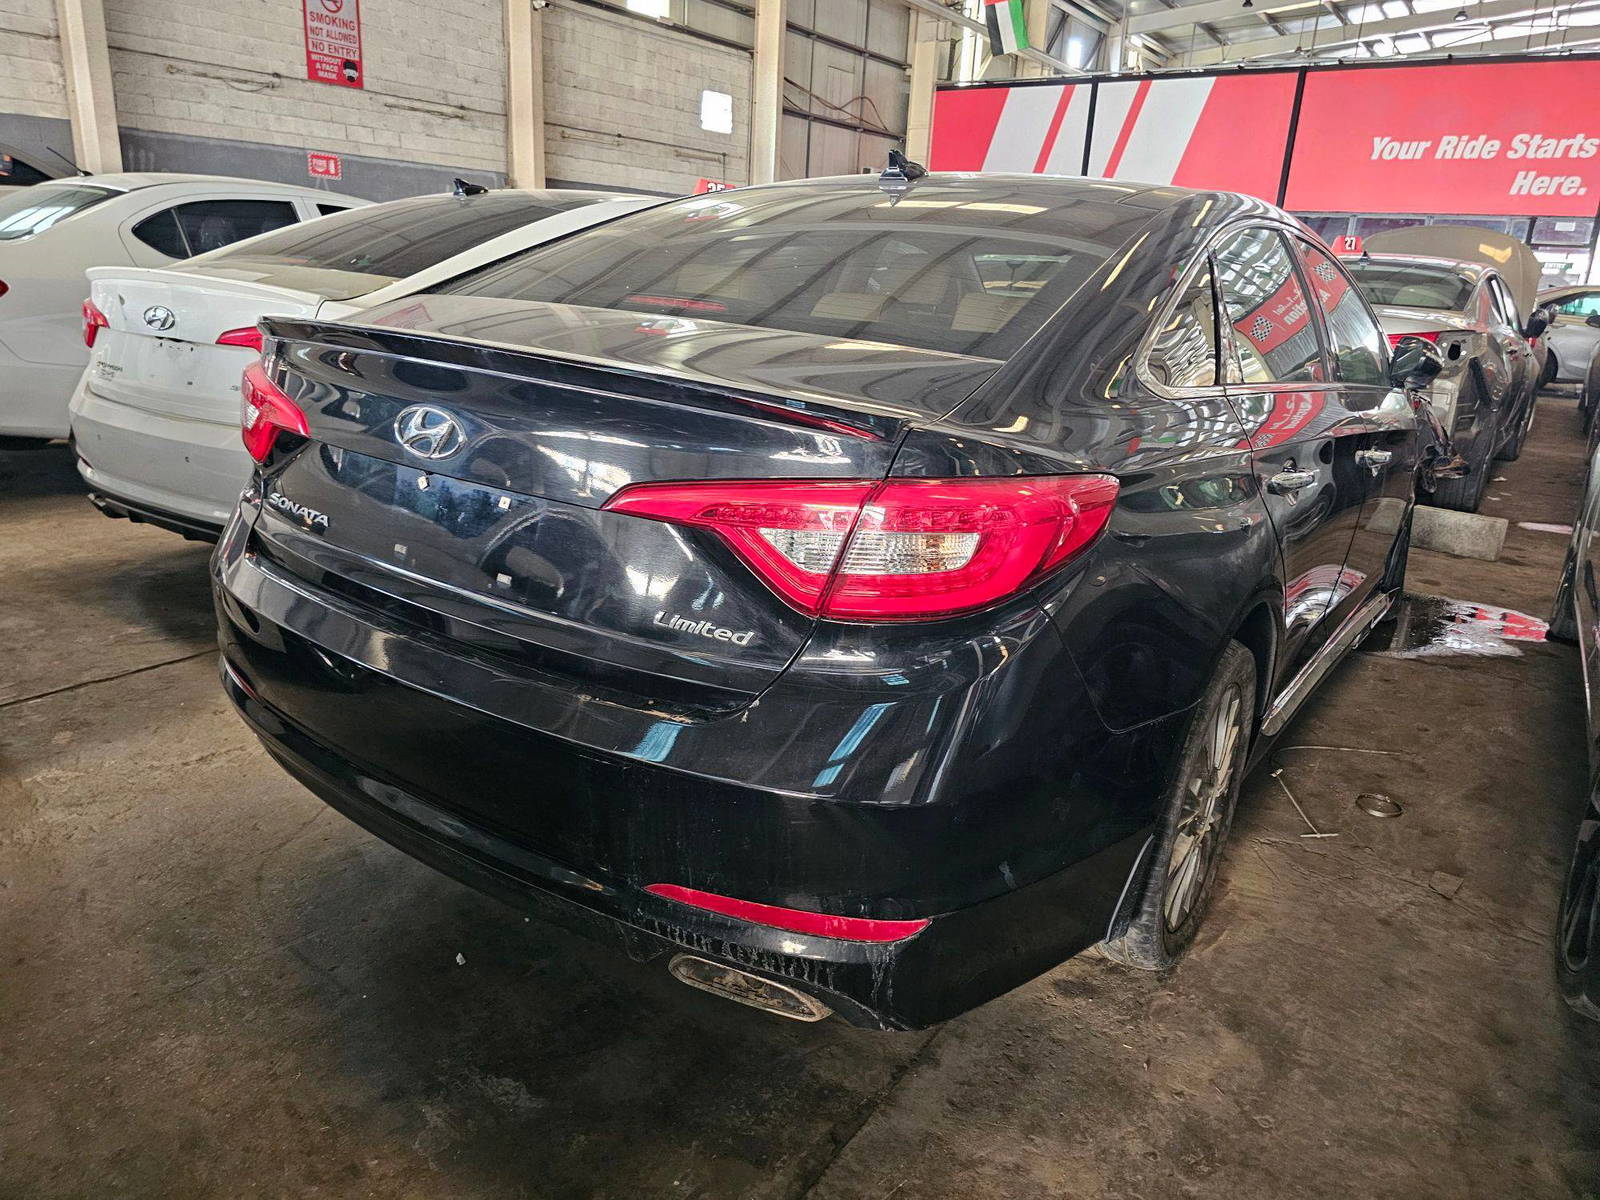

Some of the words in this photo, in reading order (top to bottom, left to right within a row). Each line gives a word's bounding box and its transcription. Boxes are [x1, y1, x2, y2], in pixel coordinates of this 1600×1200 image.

[309, 11, 356, 31] SMOKING
[310, 26, 324, 37] NOT
[326, 29, 358, 44] ALLOWED
[311, 40, 325, 52] NO
[328, 44, 357, 58] ENTRY
[1371, 136, 1431, 160] Your
[1435, 135, 1501, 159] Ride
[1507, 133, 1600, 159] Starts
[1508, 171, 1587, 195] Here.
[1344, 236, 1356, 250] 27
[268, 492, 329, 527] SONATA
[653, 609, 755, 646] Limited
